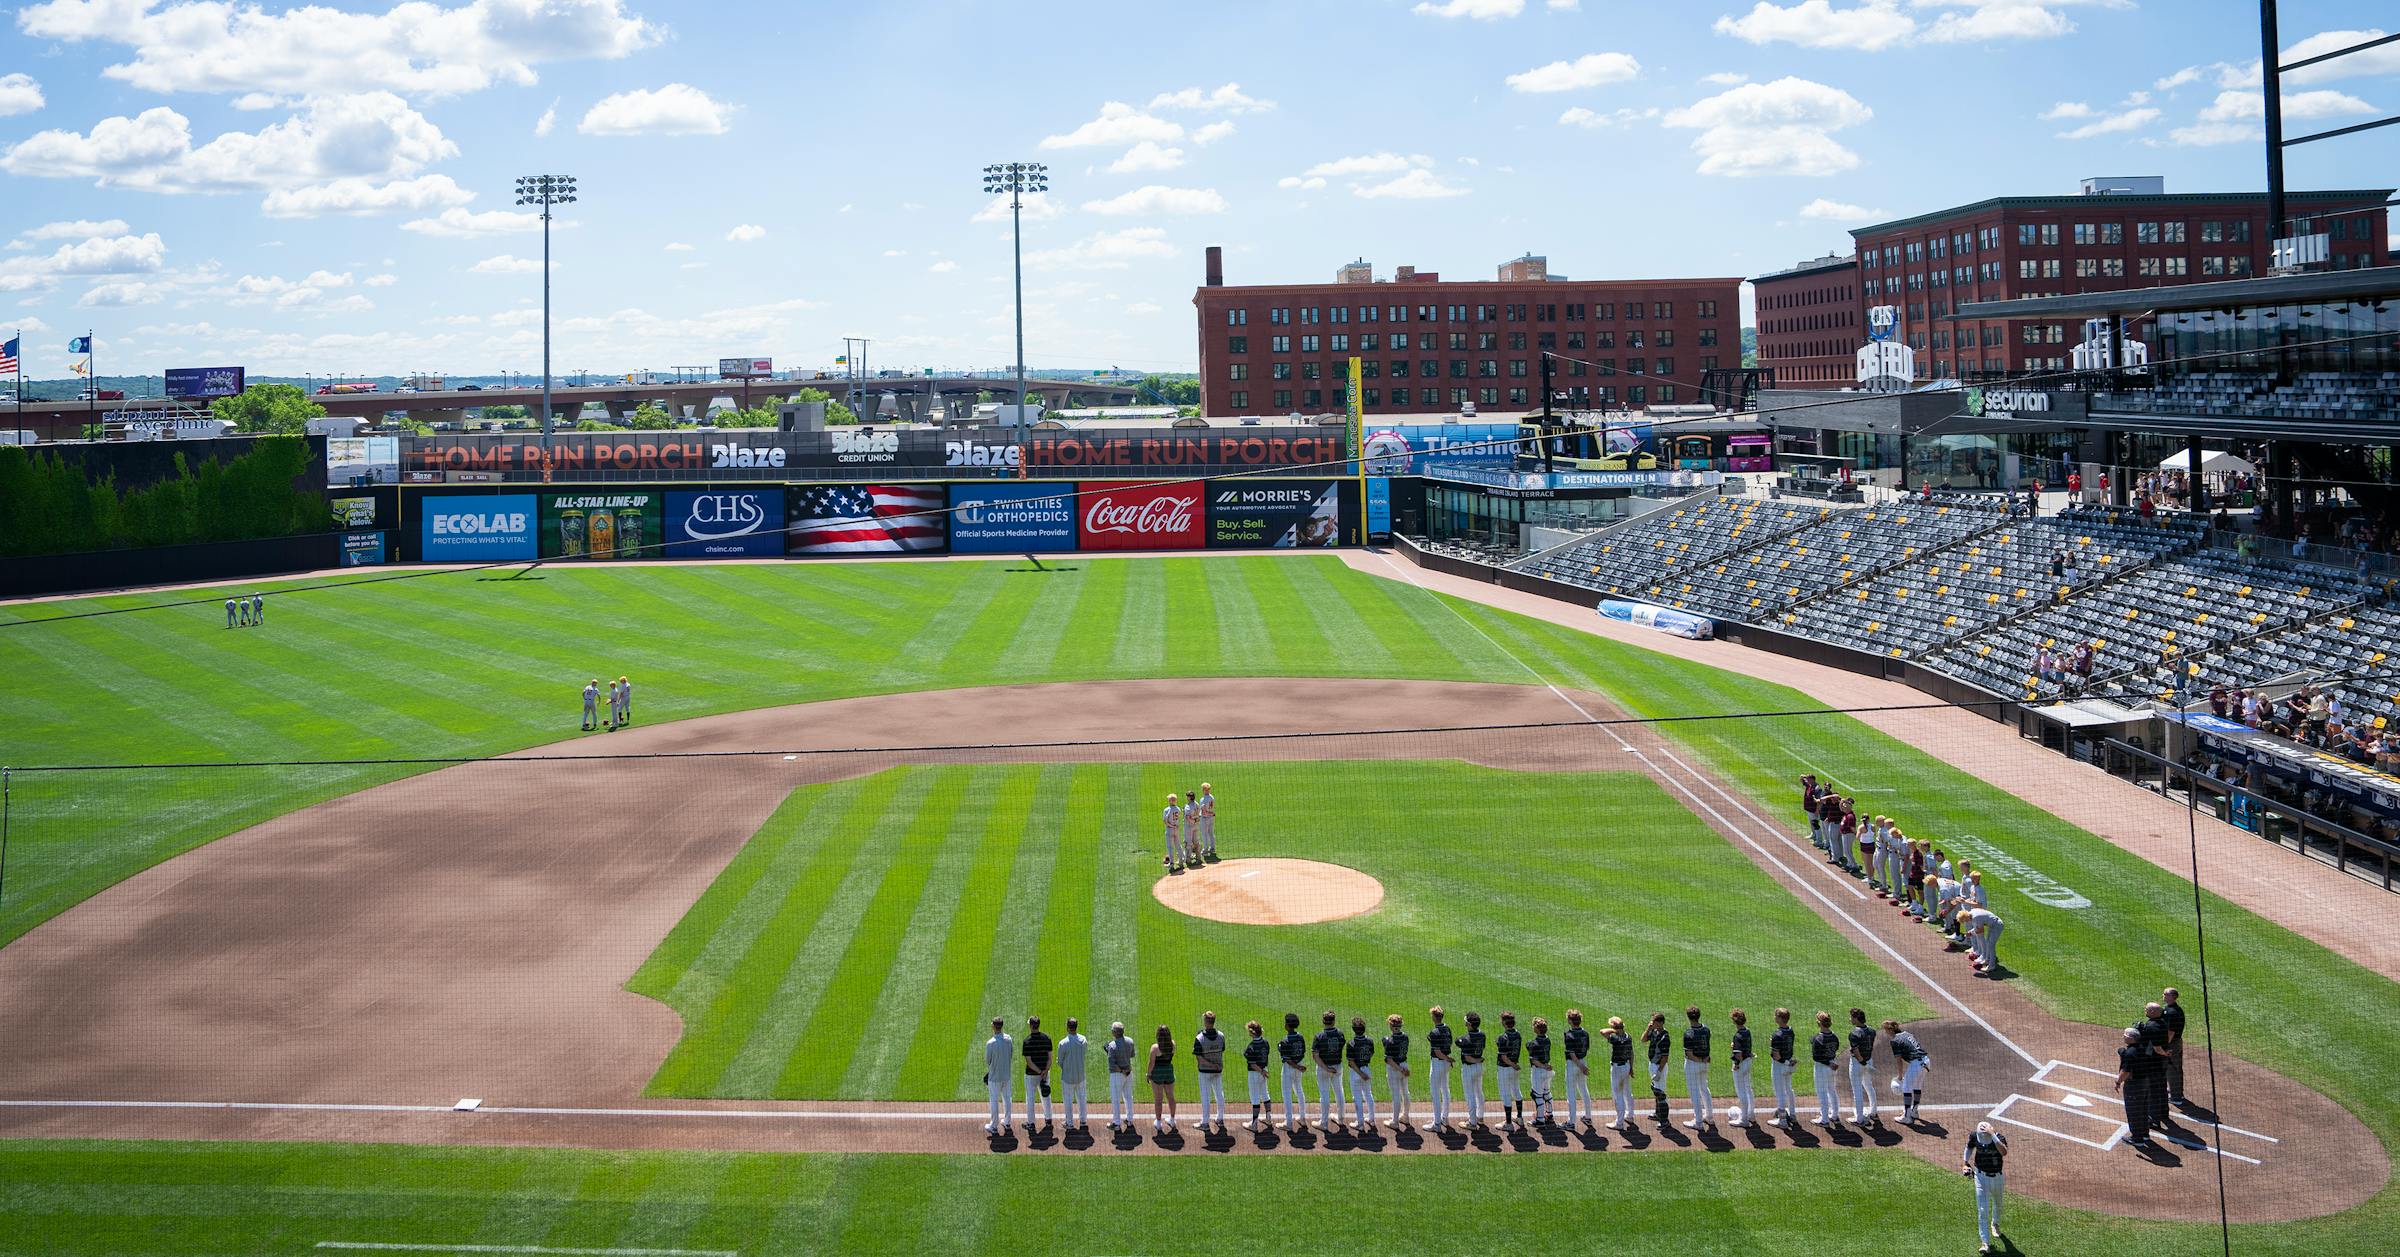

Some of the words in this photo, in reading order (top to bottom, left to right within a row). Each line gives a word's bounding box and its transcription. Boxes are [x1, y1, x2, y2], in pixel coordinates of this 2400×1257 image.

[1985, 391, 2049, 411] securian
[1348, 406, 1358, 458] Minnesota
[832, 431, 899, 454] Blaze
[424, 446, 513, 470] HOME
[524, 445, 583, 470] RUN
[595, 443, 702, 470] PORCH
[712, 443, 786, 468] Blaze
[946, 440, 1020, 466] Blaze
[1034, 439, 1131, 465] HOME
[1142, 438, 1208, 465] RUN
[1220, 437, 1336, 464] PORCH
[838, 455, 866, 463] CREDIT
[868, 454, 894, 462] UNION
[1563, 474, 1632, 484] DESTINATION
[1635, 474, 1656, 482] FUN
[1243, 490, 1311, 502] MORRIE'S
[1521, 490, 1554, 498] TERRACE
[554, 497, 605, 508] ALL-STAR
[605, 496, 648, 507] LINE-UP
[994, 499, 1023, 510] TWIN
[1027, 499, 1062, 509] CITIES
[692, 495, 756, 523] CHS
[1085, 497, 1199, 533] Coca-Cola
[350, 519, 373, 527] below.
[433, 513, 527, 534] ECOLAB
[988, 512, 1069, 523] ORTHOPEDICS
[1216, 520, 1241, 530] Buy.
[1243, 519, 1266, 528] Sell.
[956, 530, 981, 538] Official
[982, 530, 1005, 539] Sports
[1006, 529, 1037, 537] Medicine
[1039, 529, 1069, 537] Provider
[1216, 531, 1262, 541] Service.
